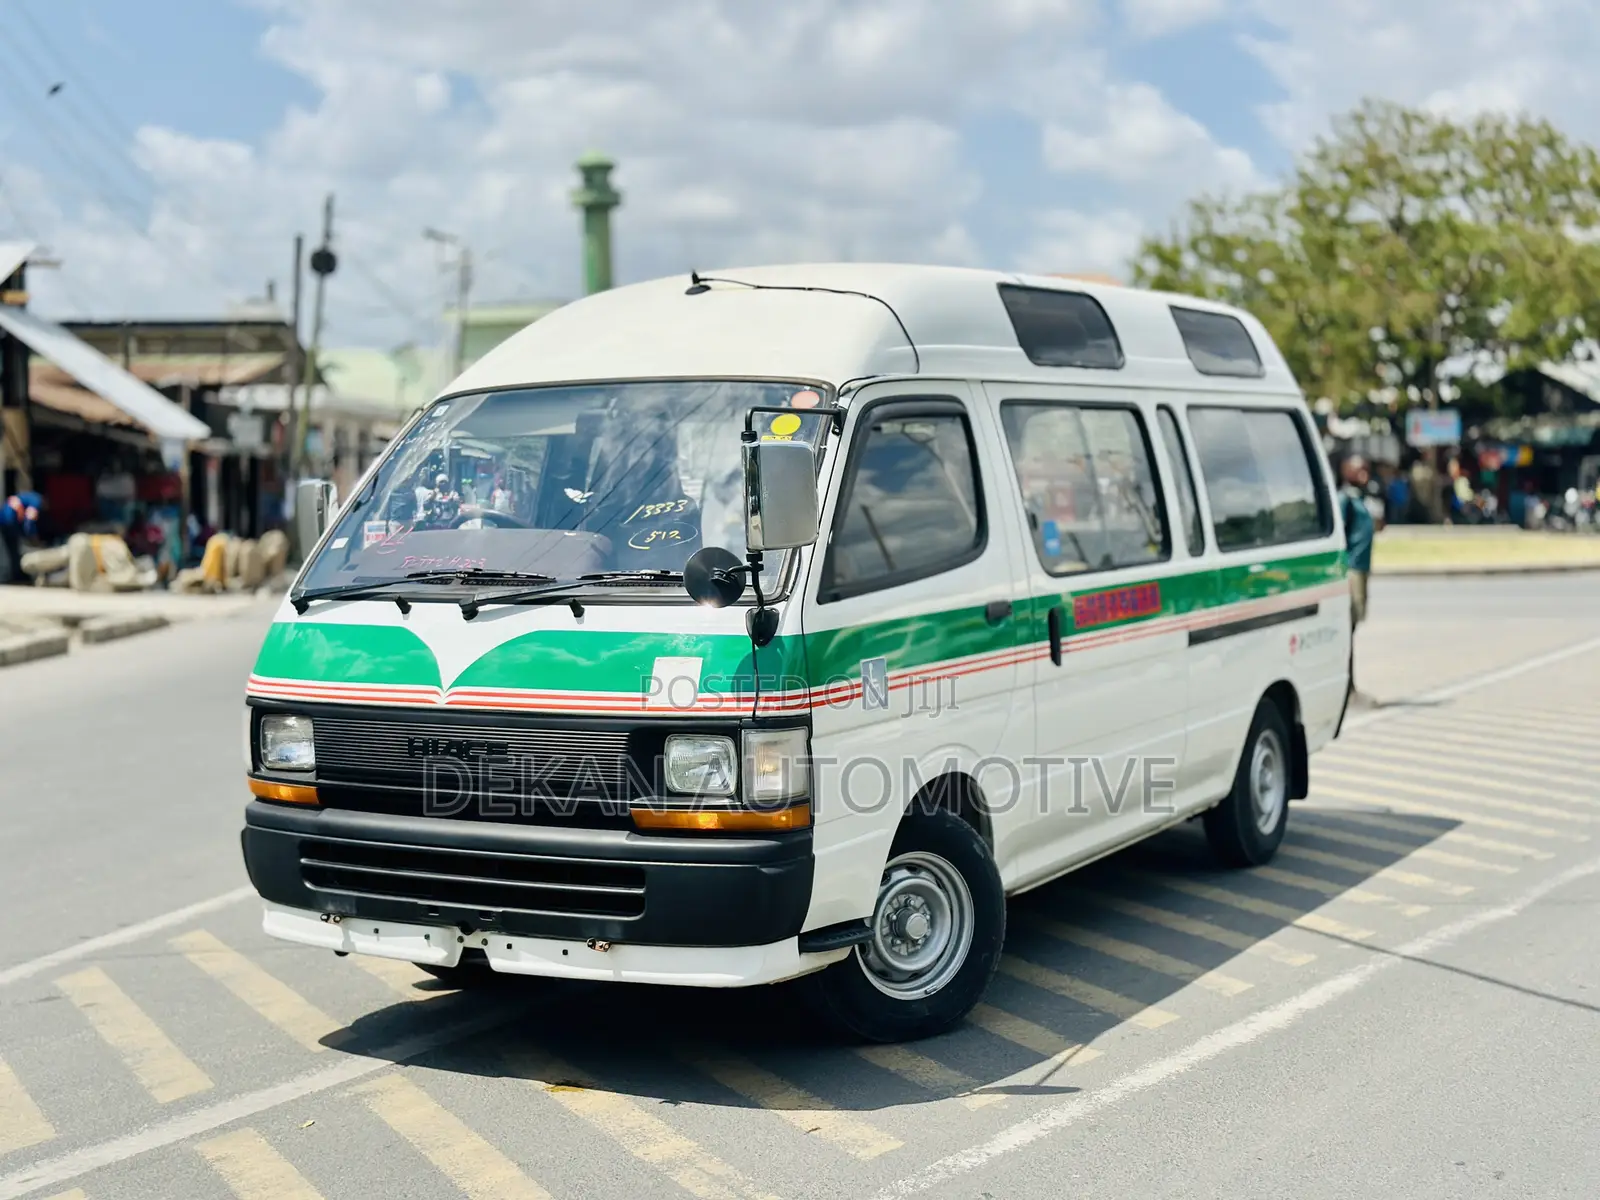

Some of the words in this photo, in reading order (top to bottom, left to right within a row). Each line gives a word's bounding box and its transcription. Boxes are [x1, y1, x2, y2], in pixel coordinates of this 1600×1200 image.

[623, 499, 689, 525] 13333
[643, 530, 682, 543] 512
[407, 737, 509, 763] HIACE
